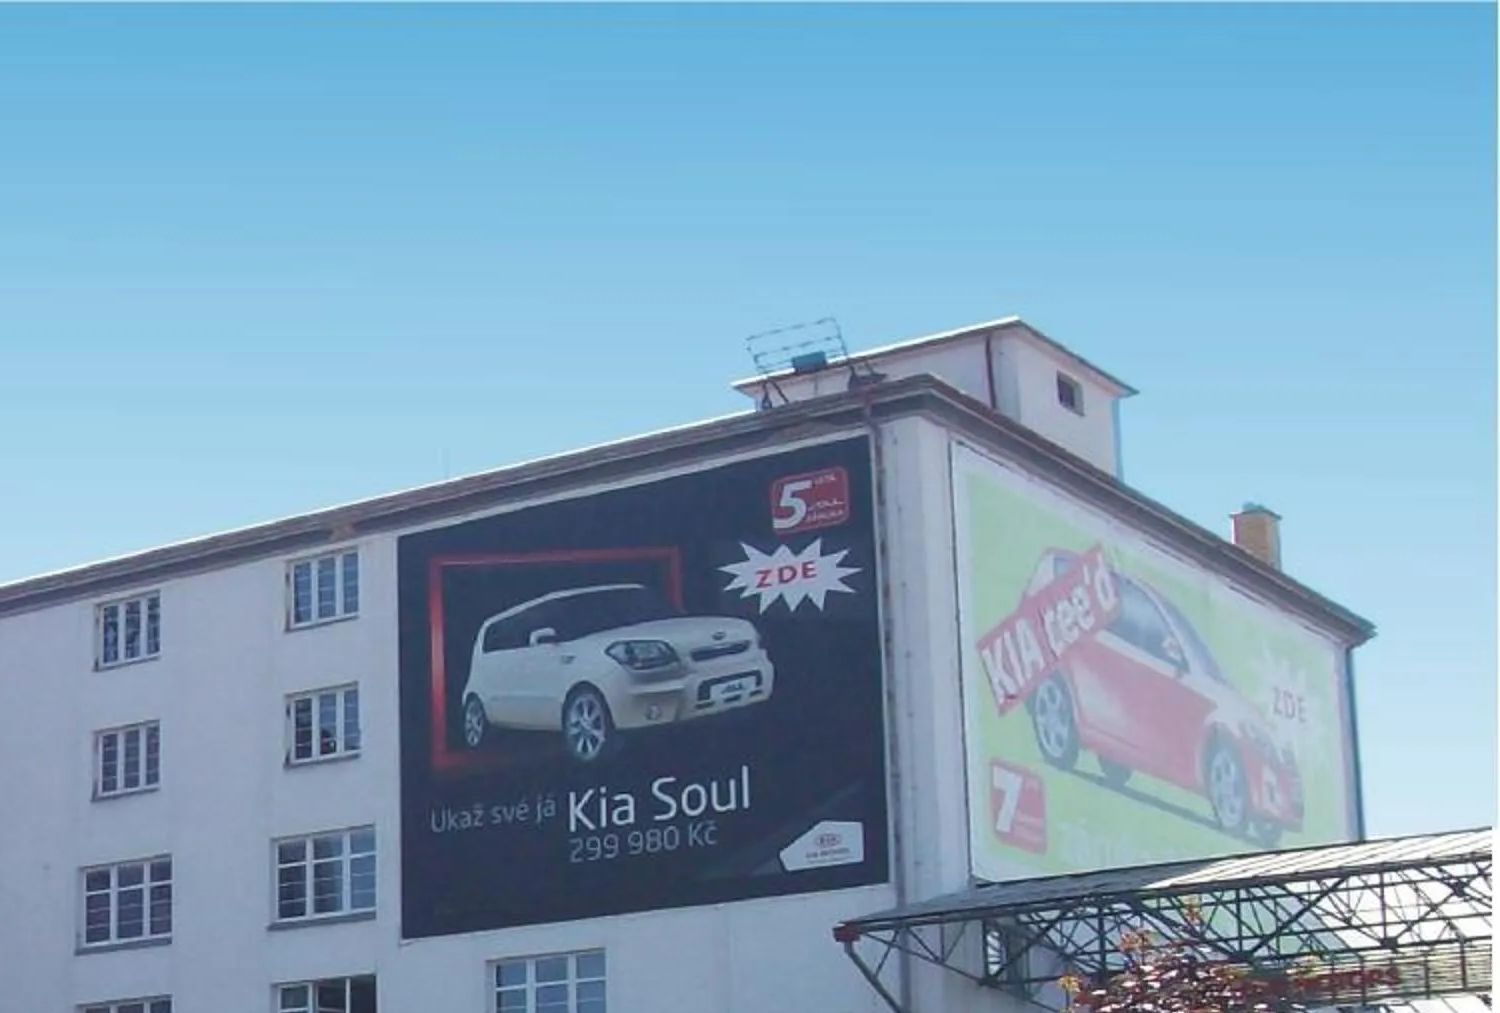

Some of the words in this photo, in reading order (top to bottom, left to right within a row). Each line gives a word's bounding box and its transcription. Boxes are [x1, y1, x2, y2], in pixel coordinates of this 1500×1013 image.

[772, 479, 813, 529] 5
[755, 560, 818, 589] ZDE
[981, 617, 1047, 705] KIA
[430, 803, 484, 833] Ukaž
[491, 800, 529, 825] své
[535, 797, 557, 825] já
[568, 787, 636, 833] Kia
[651, 765, 750, 821] Soul
[993, 765, 1024, 833] 7
[569, 832, 620, 863] 299
[627, 825, 681, 856] 980
[687, 819, 719, 847] Kč
